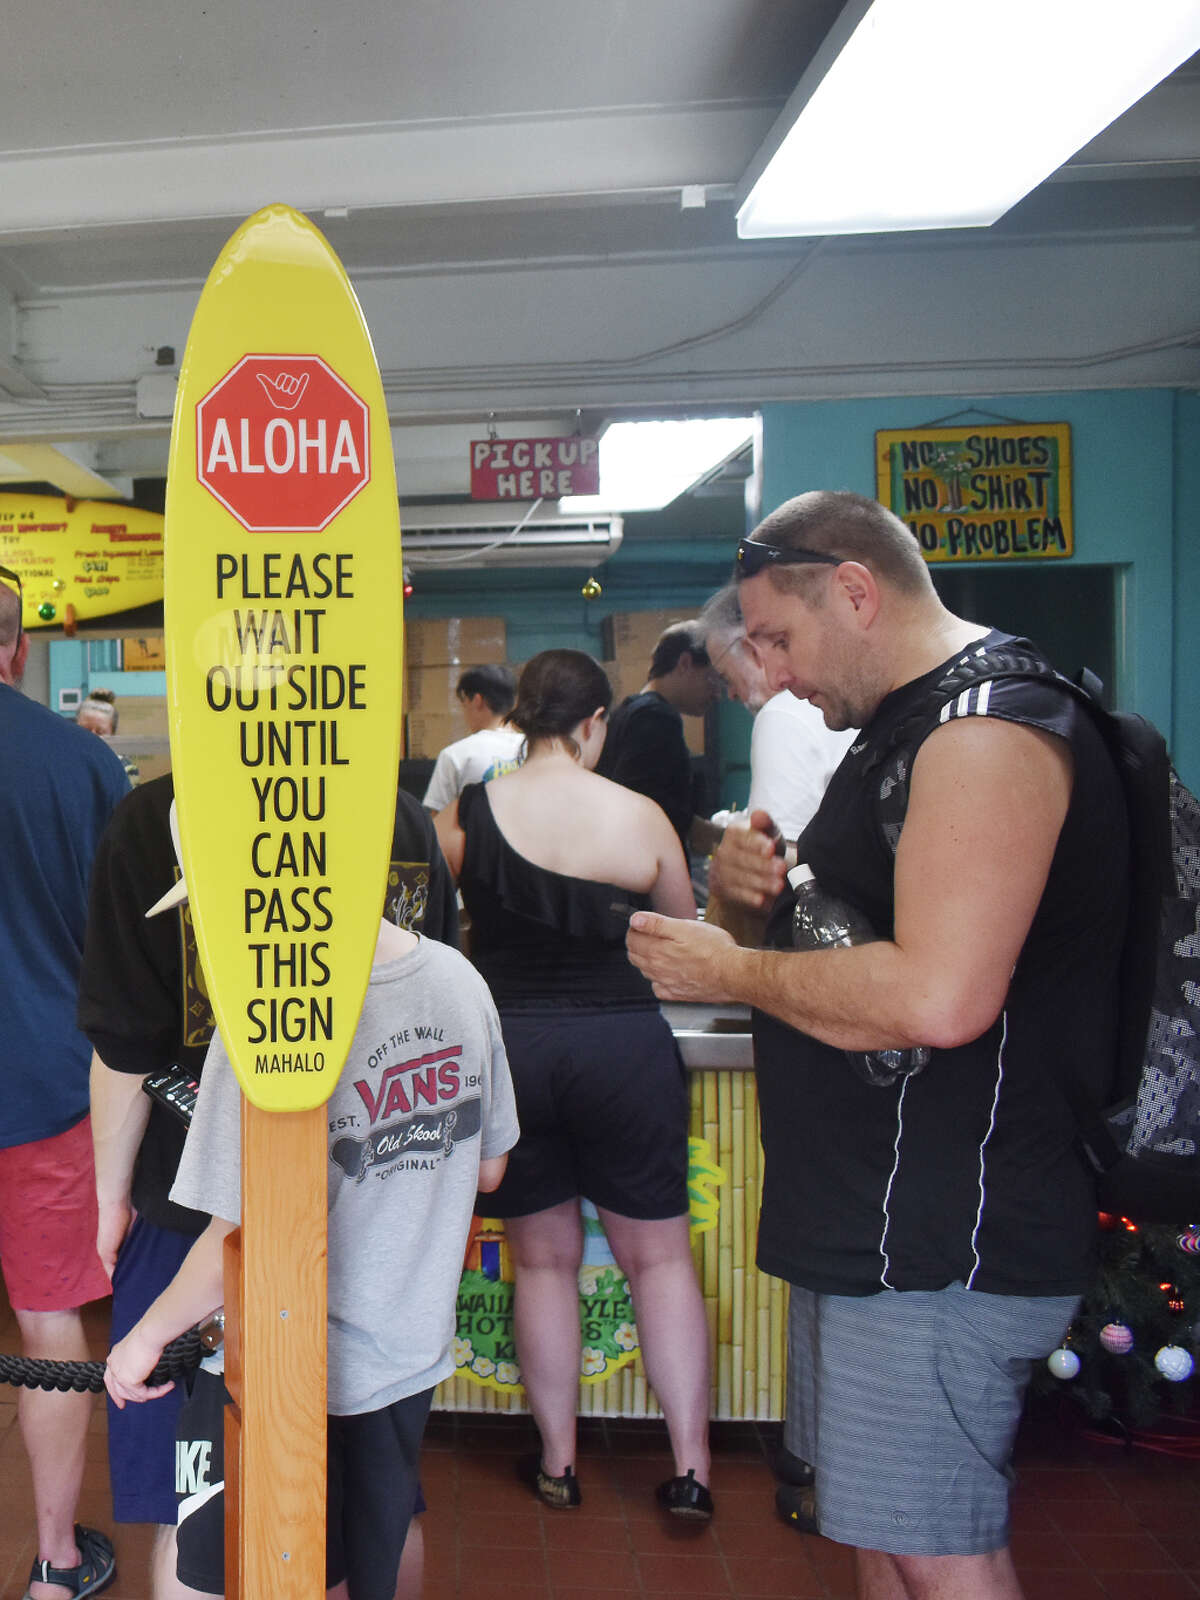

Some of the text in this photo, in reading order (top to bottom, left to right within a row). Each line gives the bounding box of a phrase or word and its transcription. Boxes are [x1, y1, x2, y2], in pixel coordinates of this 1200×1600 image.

[206, 417, 362, 475] ALOHA
[901, 434, 1050, 471] NO SHOES
[497, 469, 574, 497] HERE
[904, 476, 938, 512] NO
[946, 516, 1067, 555] PROBLEM
[217, 553, 354, 599] PLEASE
[233, 609, 326, 654] WAIT
[206, 664, 367, 712] OUTSIDE
[240, 720, 350, 767] UNTIL
[251, 776, 326, 822] YOU
[251, 831, 326, 879] CAN
[244, 886, 333, 934] PASS
[247, 941, 332, 989] THIS
[246, 996, 334, 1044] SIGN
[254, 1051, 326, 1075] MAHALO
[367, 1026, 446, 1070] OFF THE WALL
[353, 1044, 464, 1126] VANS
[328, 1115, 361, 1133] EST.
[376, 1122, 443, 1156] Old Skool
